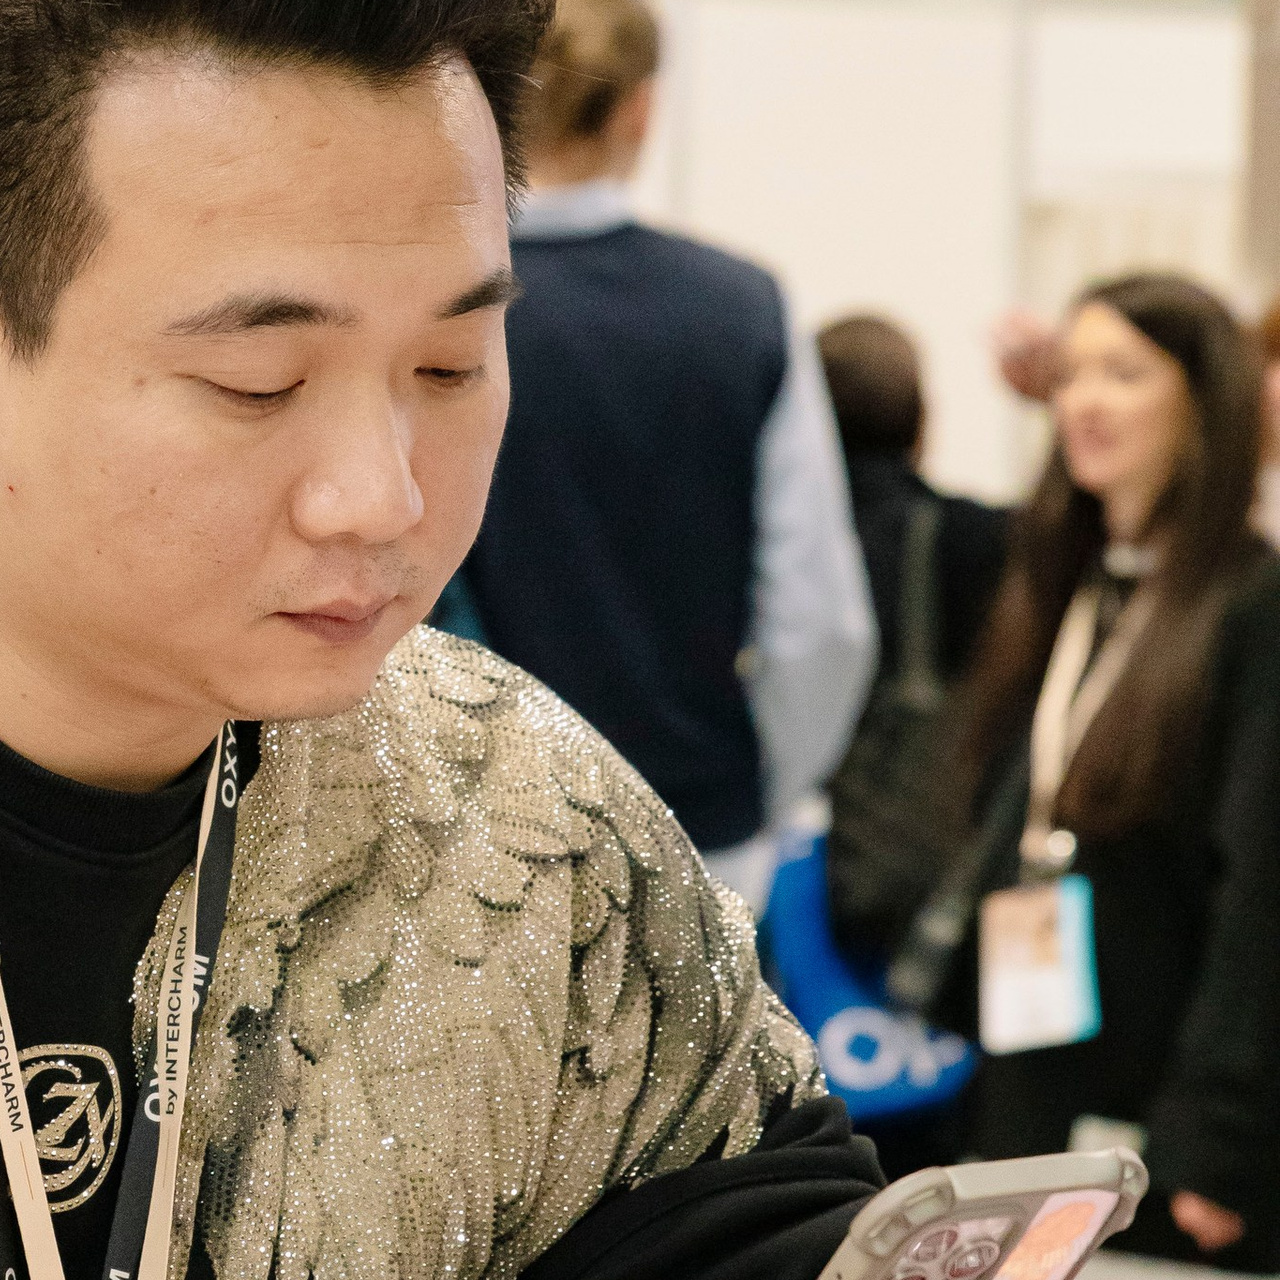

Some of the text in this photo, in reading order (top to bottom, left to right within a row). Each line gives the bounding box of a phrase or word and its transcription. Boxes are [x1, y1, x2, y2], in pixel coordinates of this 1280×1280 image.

[221, 719, 238, 808] OXY
[165, 926, 188, 1115] by INTERCHARM
